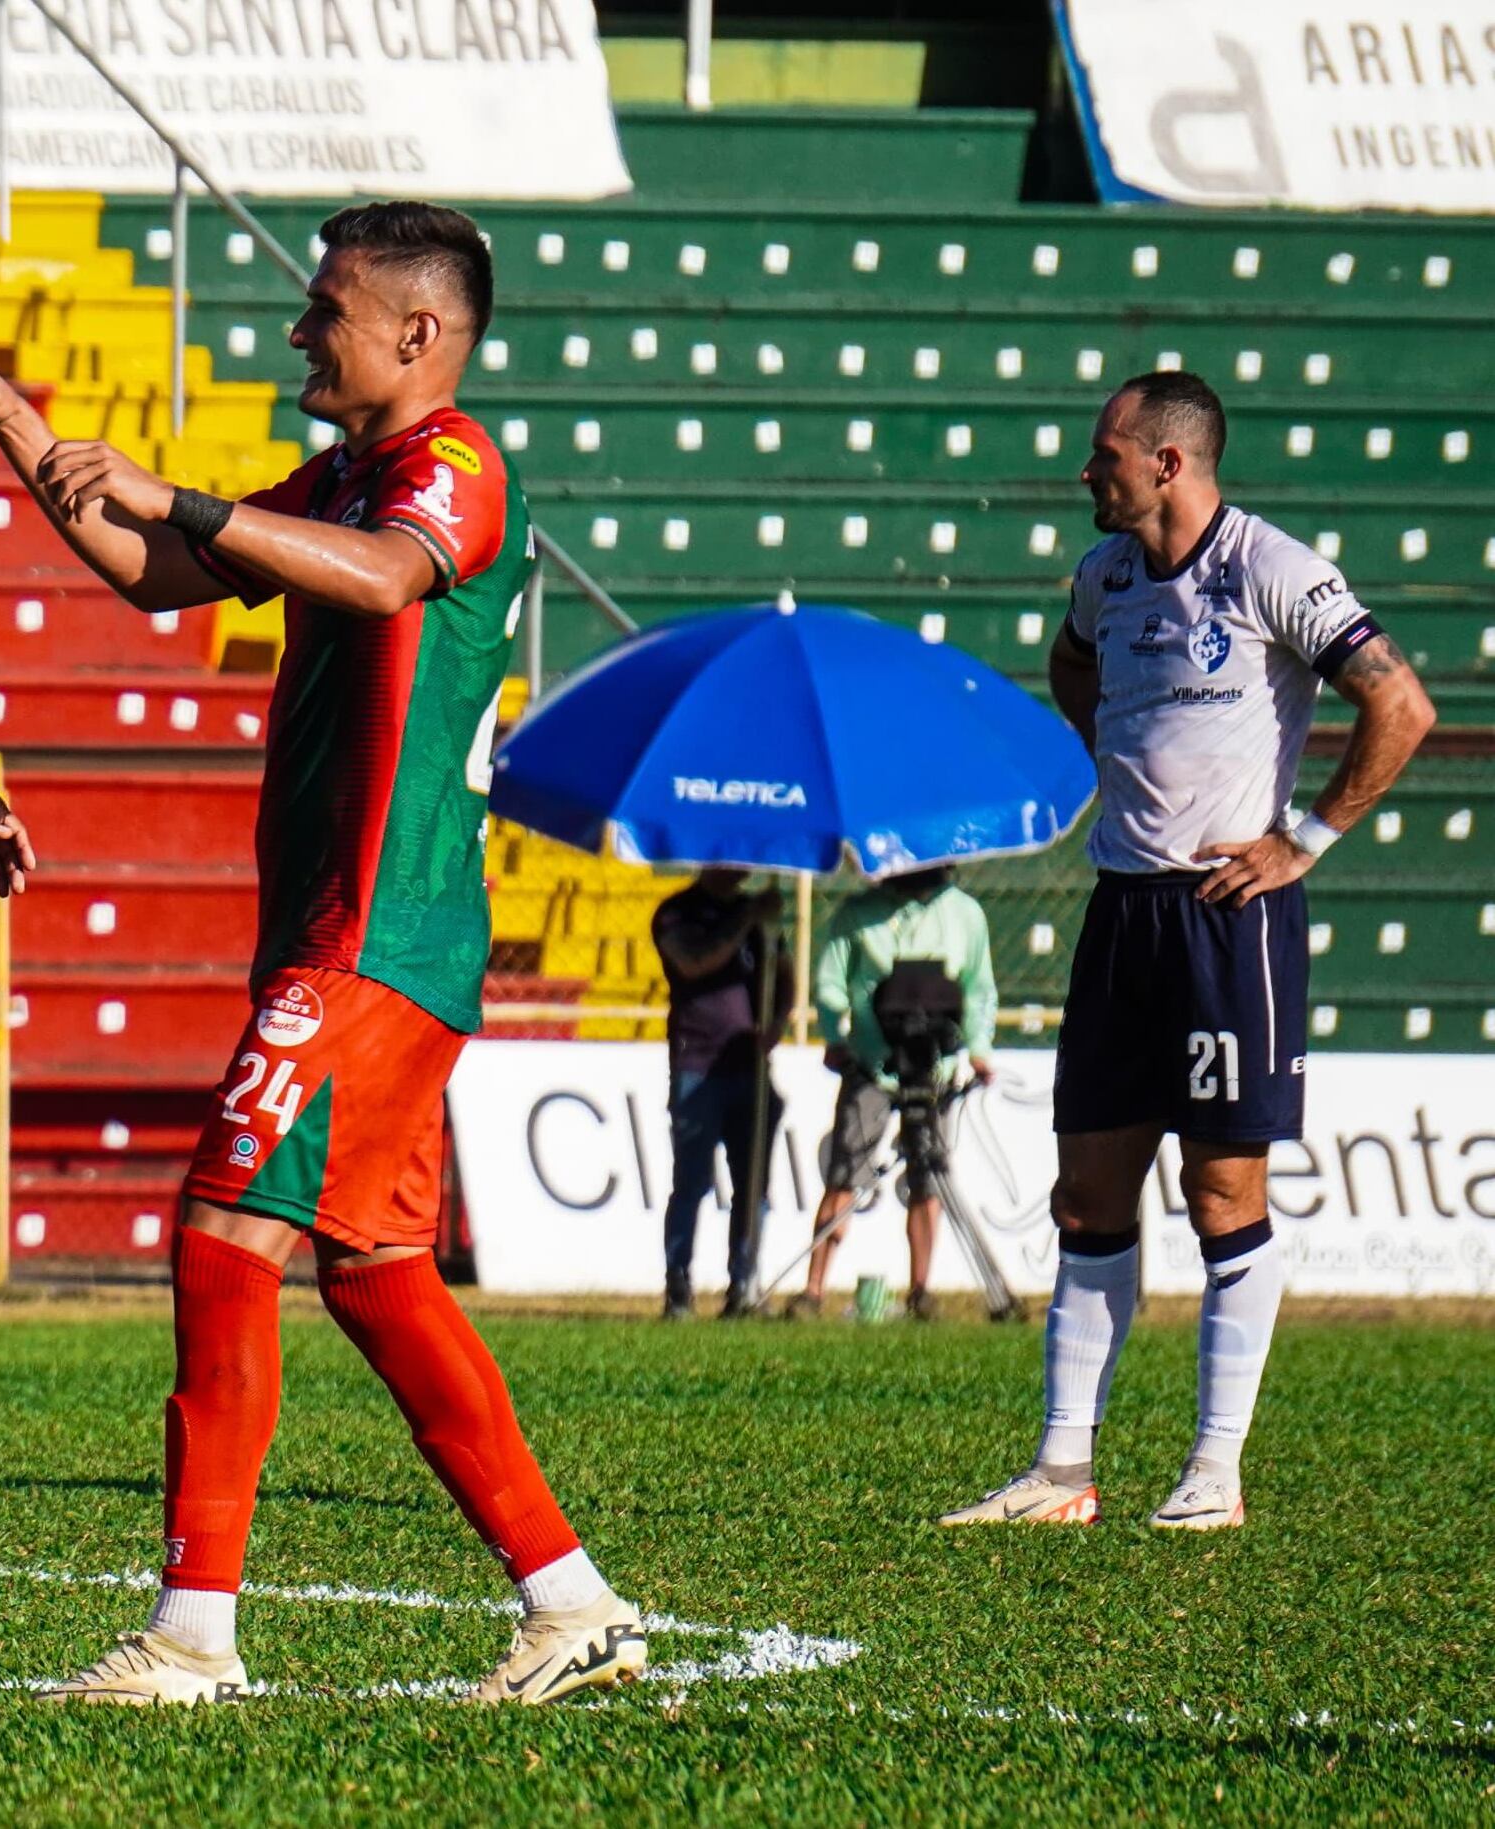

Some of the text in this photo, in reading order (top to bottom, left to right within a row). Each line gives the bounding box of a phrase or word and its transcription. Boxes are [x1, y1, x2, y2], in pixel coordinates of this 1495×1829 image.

[374, 0, 575, 62] CLARA
[1172, 686, 1244, 699] VillaPlants
[222, 1052, 304, 1136] 24
[1188, 1031, 1240, 1101] 21
